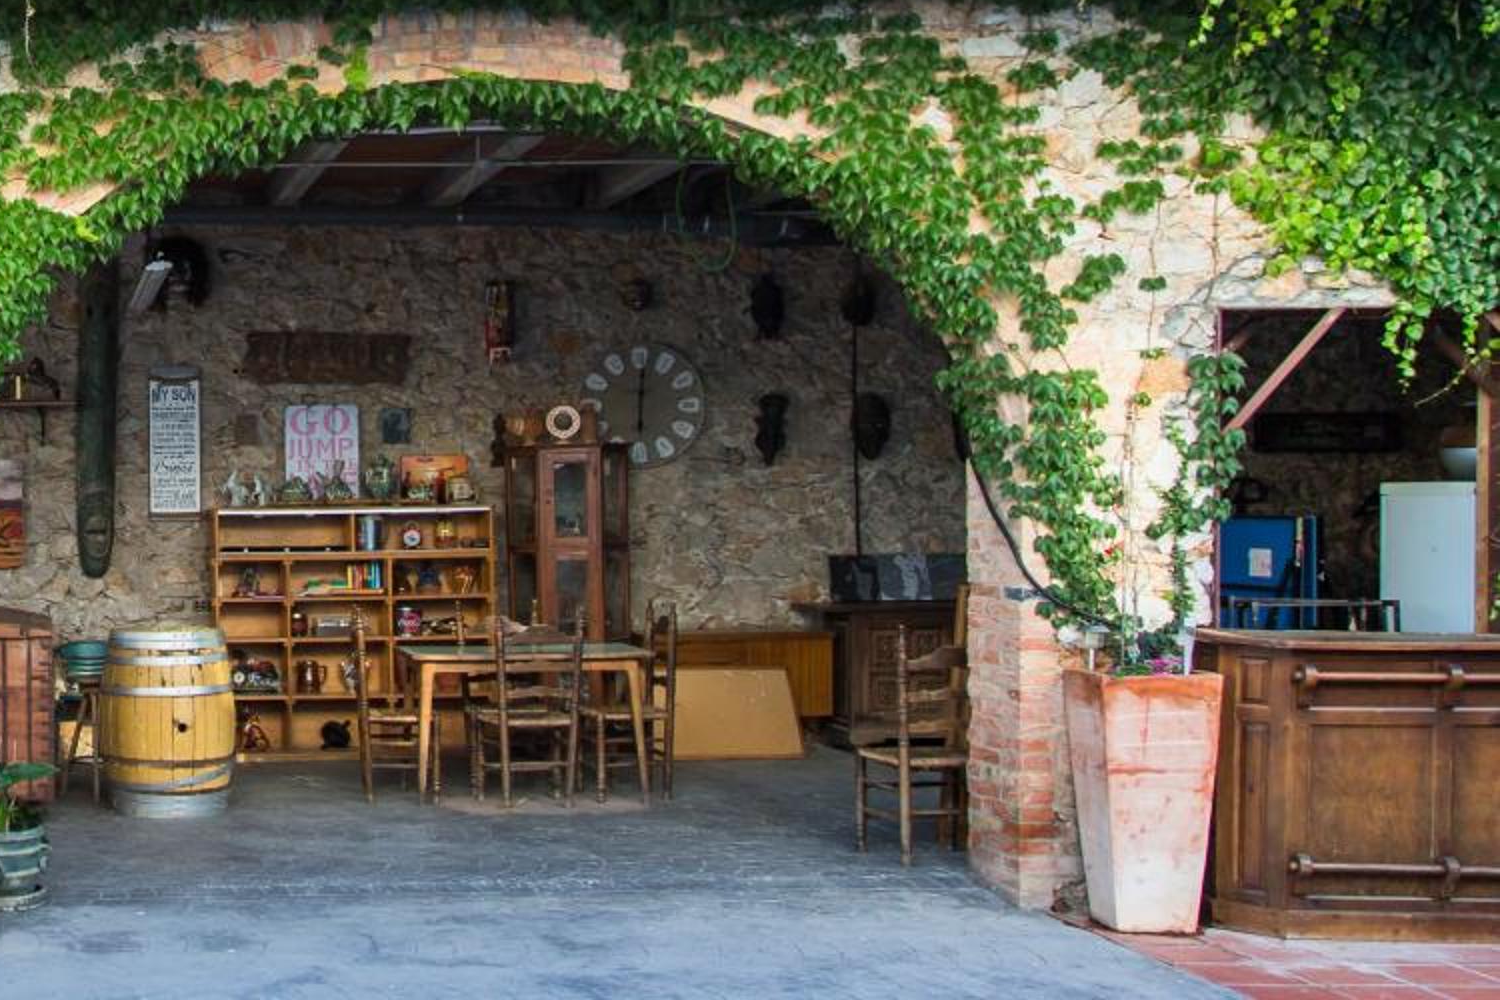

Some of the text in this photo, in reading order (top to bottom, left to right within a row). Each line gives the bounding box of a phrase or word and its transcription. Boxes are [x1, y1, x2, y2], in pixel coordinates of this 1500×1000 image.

[151, 386, 197, 403] MY SON
[290, 407, 351, 436] GO
[289, 438, 354, 459] JUMP
[296, 459, 316, 473] IN
